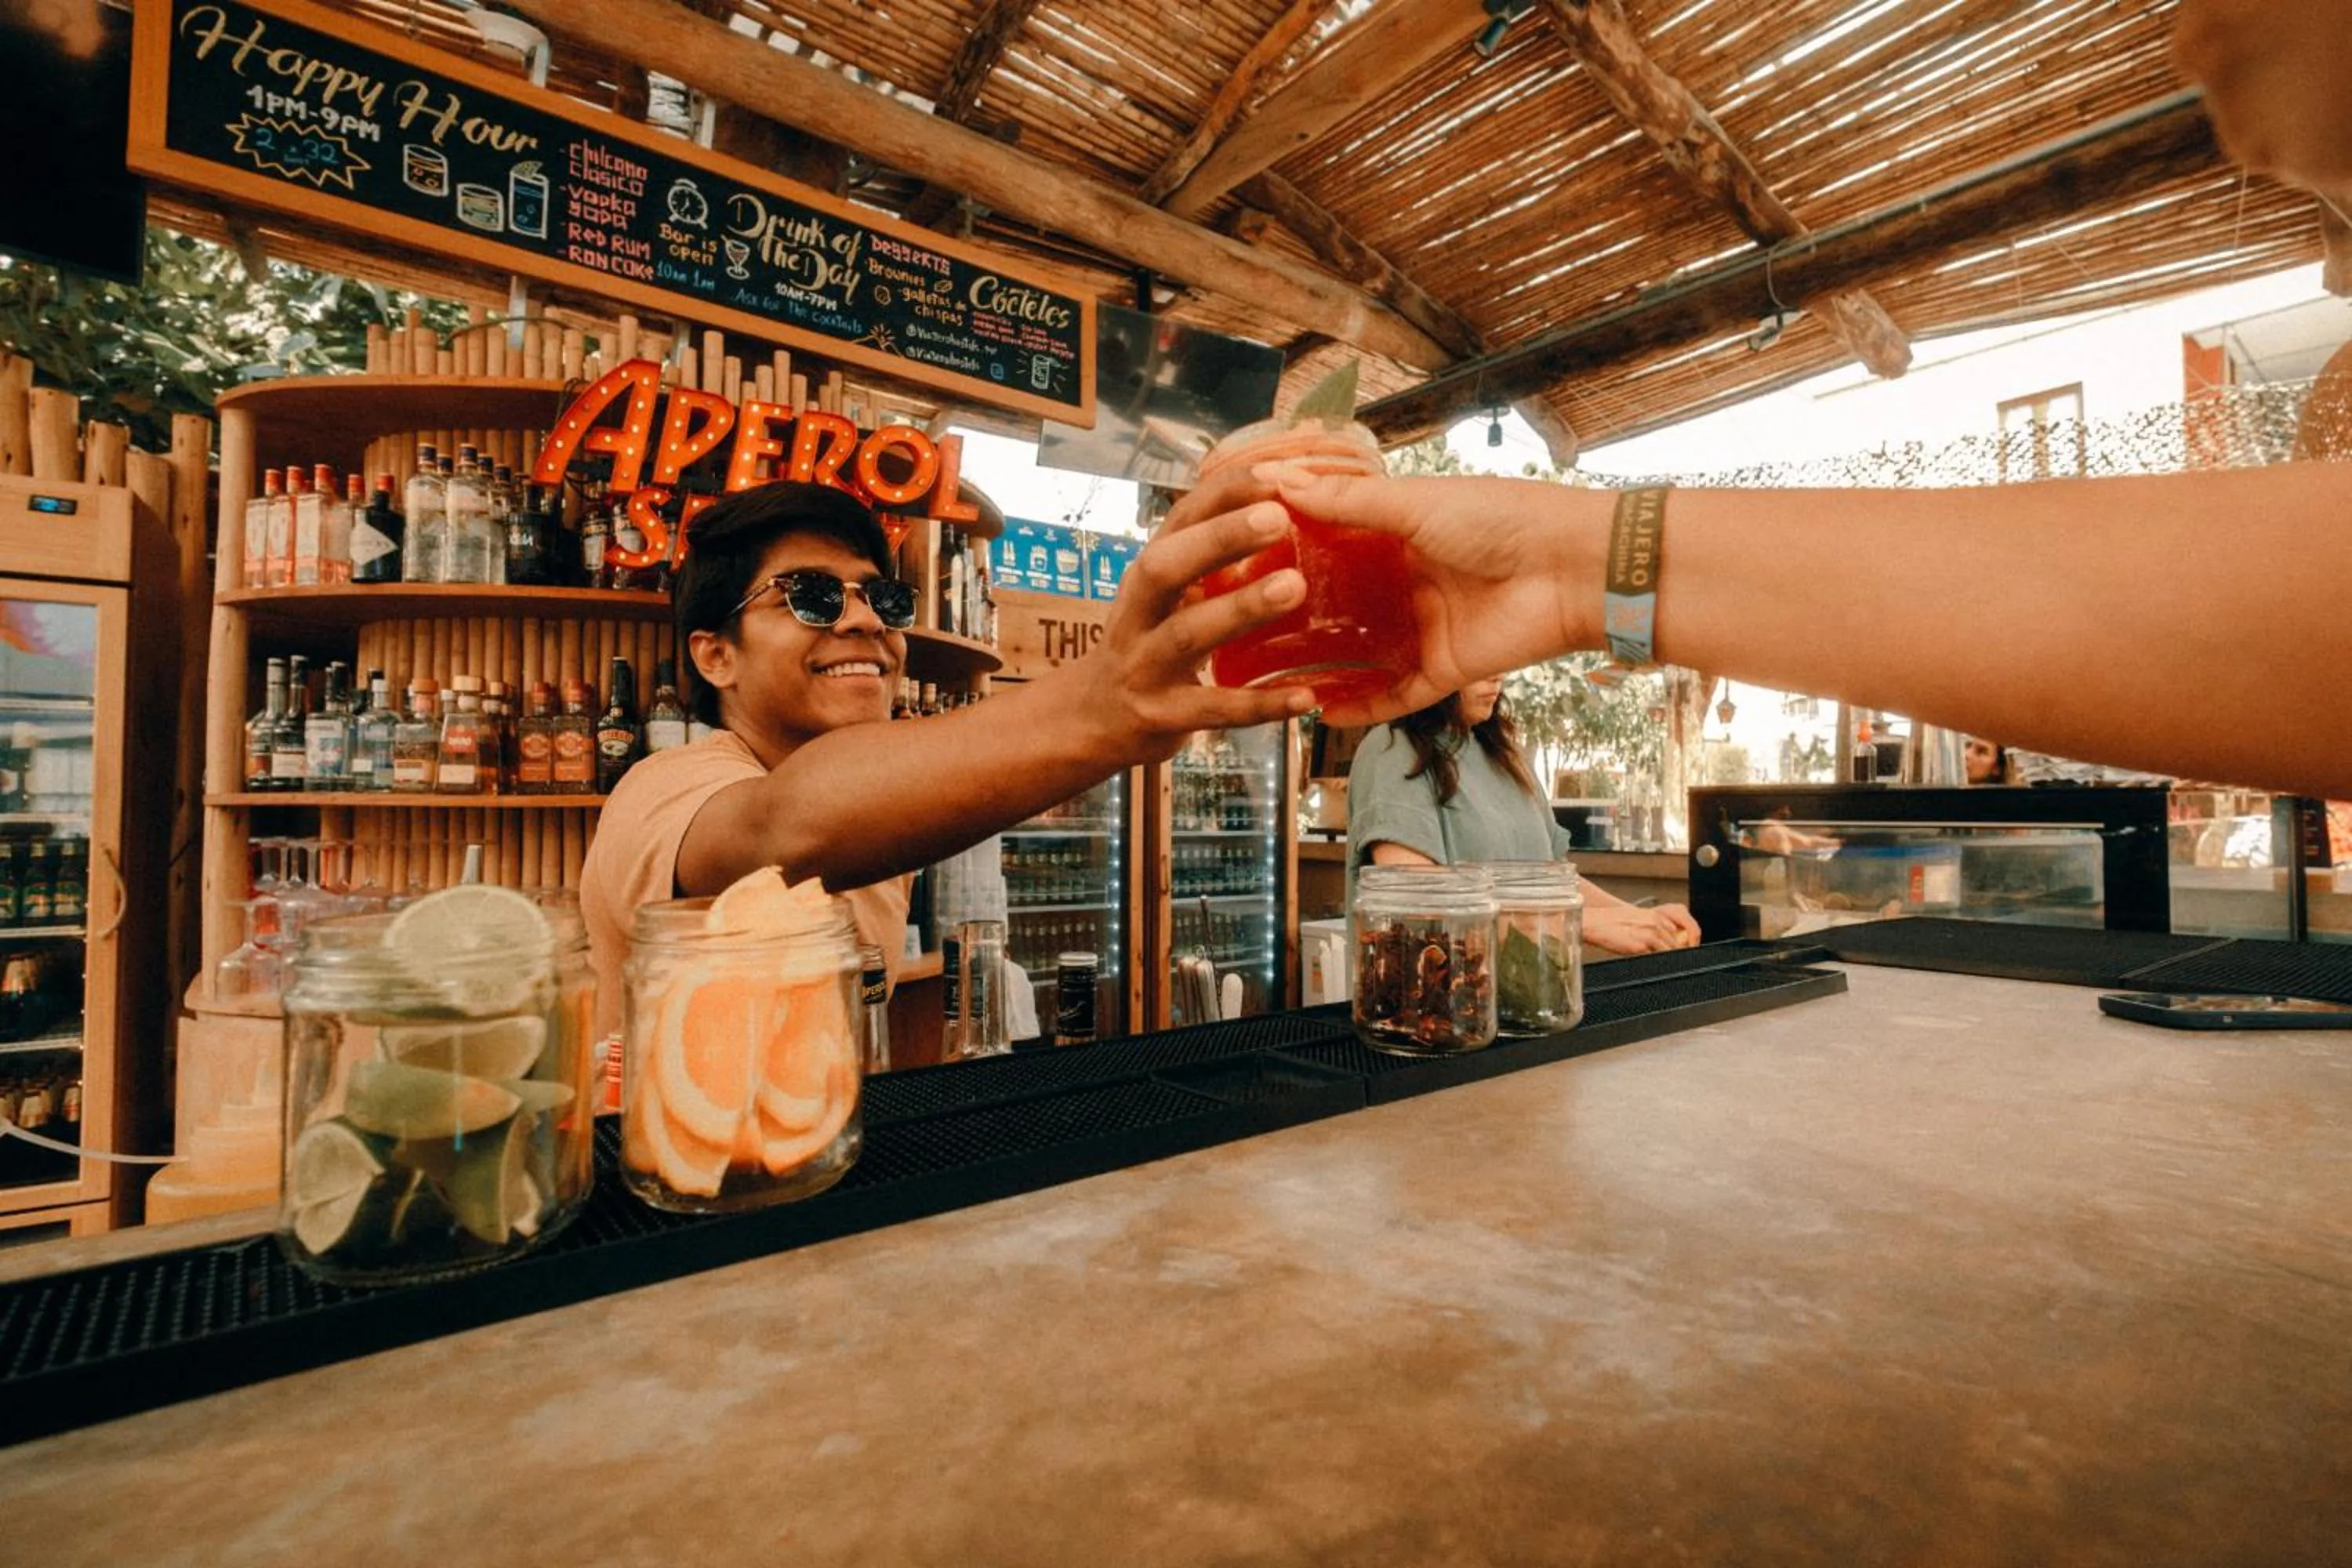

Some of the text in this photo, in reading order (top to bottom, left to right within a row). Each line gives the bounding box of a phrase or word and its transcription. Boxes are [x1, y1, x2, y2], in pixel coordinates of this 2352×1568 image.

[180, 5, 539, 153] Happy Hour
[246, 85, 381, 143] 1PM-9PM
[255, 128, 276, 150] 2
[659, 223, 718, 253] Bar is
[727, 193, 862, 267] Drink of
[774, 281, 838, 311] 10AM-7PM
[789, 248, 862, 306] Day
[868, 256, 926, 286] Brownies
[532, 358, 979, 521] APEROL
[1631, 489, 1659, 586] VIAJERO
